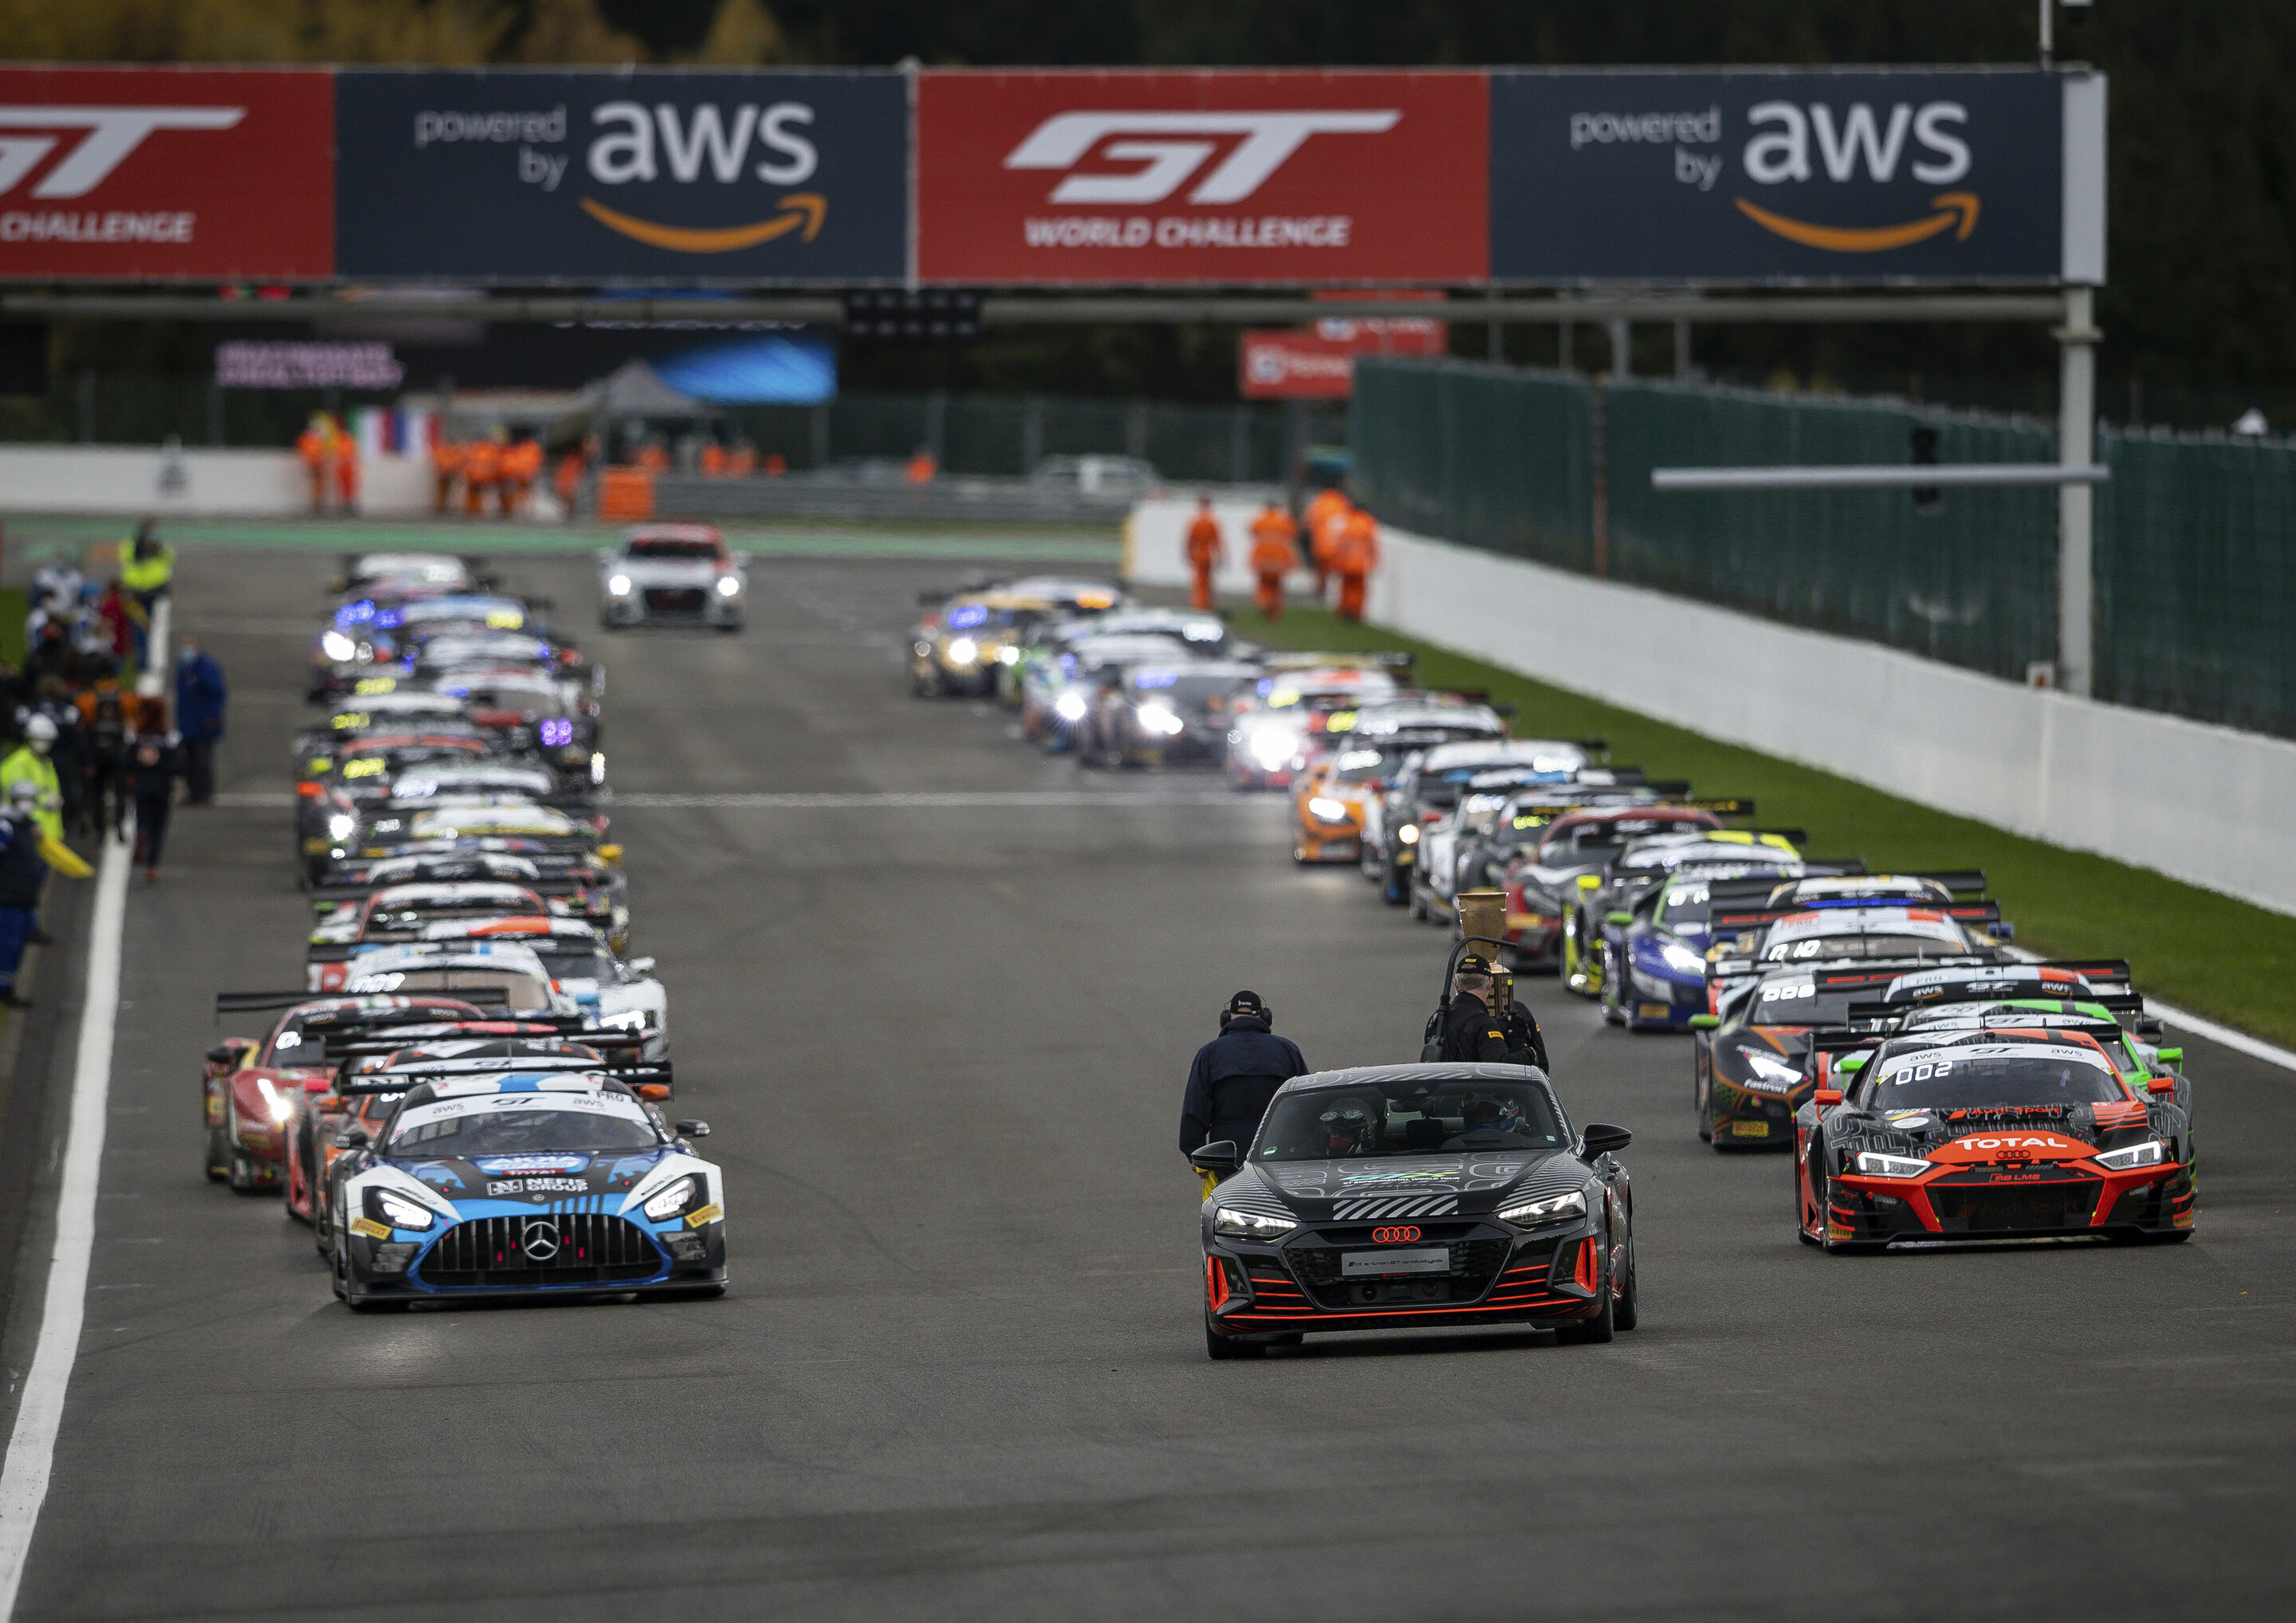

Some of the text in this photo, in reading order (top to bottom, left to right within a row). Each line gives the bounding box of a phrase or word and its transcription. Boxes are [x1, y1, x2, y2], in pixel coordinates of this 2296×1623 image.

[415, 104, 567, 150] powered
[587, 100, 820, 186] aws
[1571, 104, 1722, 151] powered
[1743, 100, 1972, 186] aws
[519, 145, 568, 191] by
[1003, 108, 1404, 205] GT
[1675, 145, 1724, 191] by
[1, 210, 197, 243] CHALLENGE
[1024, 216, 1353, 247] WORLD CHALLENGE
[1909, 1051, 1942, 1062] aws
[2051, 1048, 2082, 1057] aws
[1895, 1061, 1953, 1085] 002
[433, 1103, 465, 1114] aws
[1956, 1138, 2068, 1150] TOTAL
[525, 1177, 588, 1186] NEFIS
